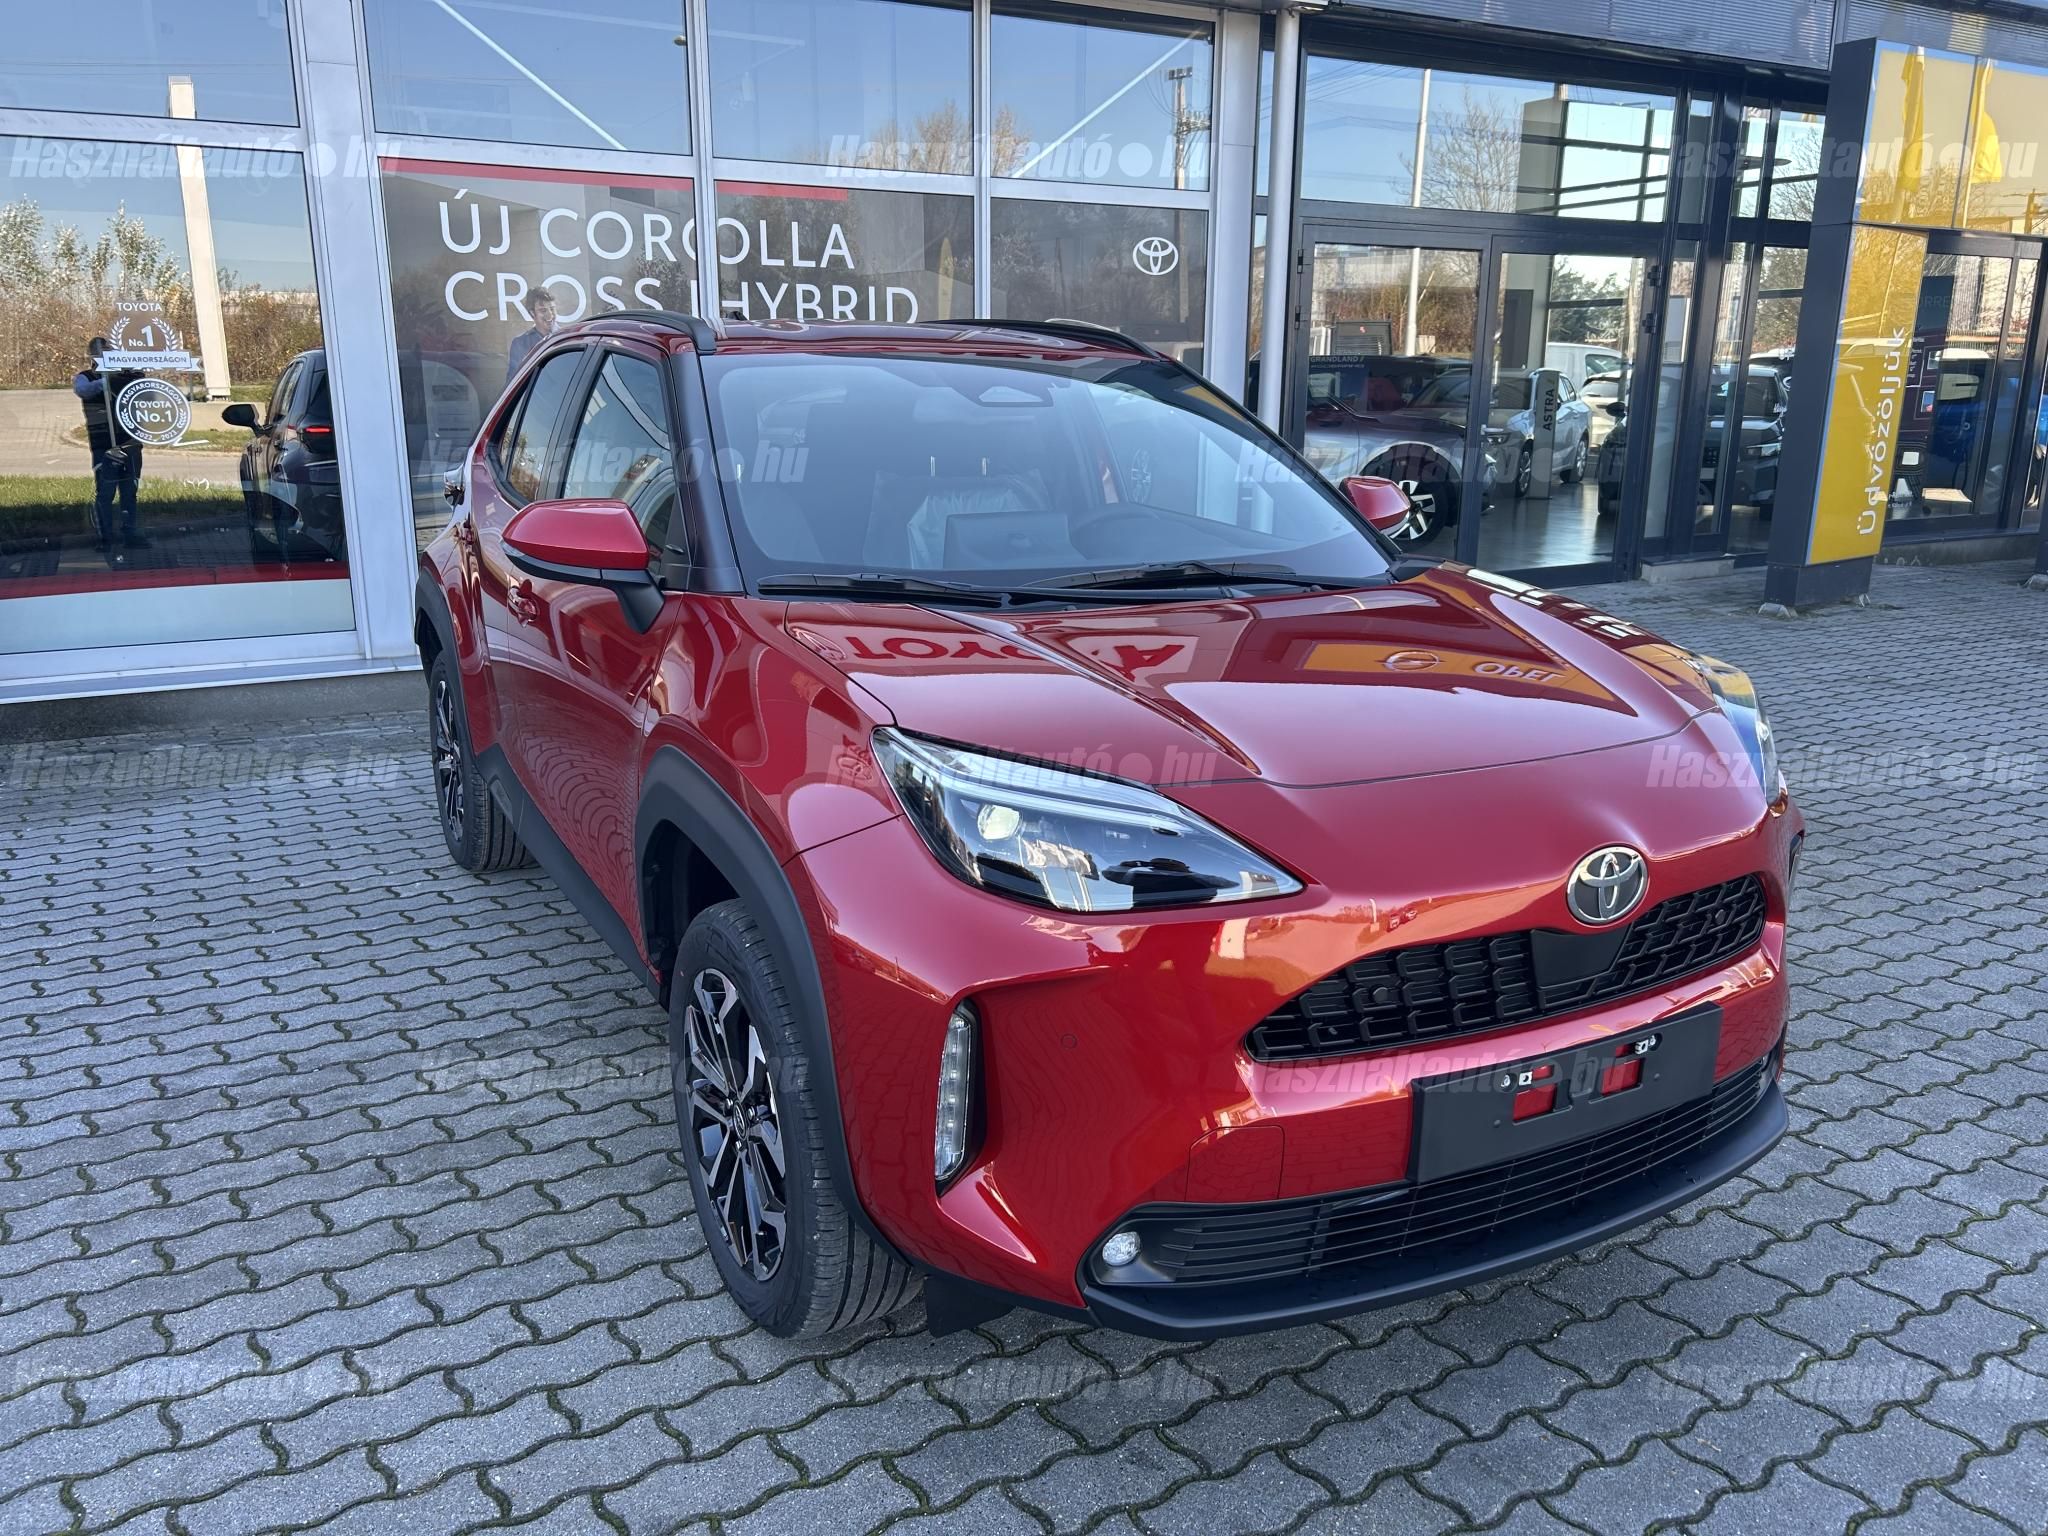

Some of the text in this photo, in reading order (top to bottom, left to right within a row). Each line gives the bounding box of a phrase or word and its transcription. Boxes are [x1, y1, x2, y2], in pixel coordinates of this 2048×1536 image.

[439, 188, 855, 269] ÚJ COROLLA
[445, 270, 919, 324] CROSS HYBRID
[116, 302, 163, 312] TOYOTA
[108, 354, 187, 364] MAGYARORSZÁGON
[121, 381, 182, 405] MAGYARORSZÁGON
[134, 400, 172, 409] TOYOTA
[1543, 388, 1555, 431] ASTRA
[136, 410, 173, 423] No.1
[135, 430, 178, 441] 2022 2023
[1856, 326, 1906, 535] Üdvözöljük
